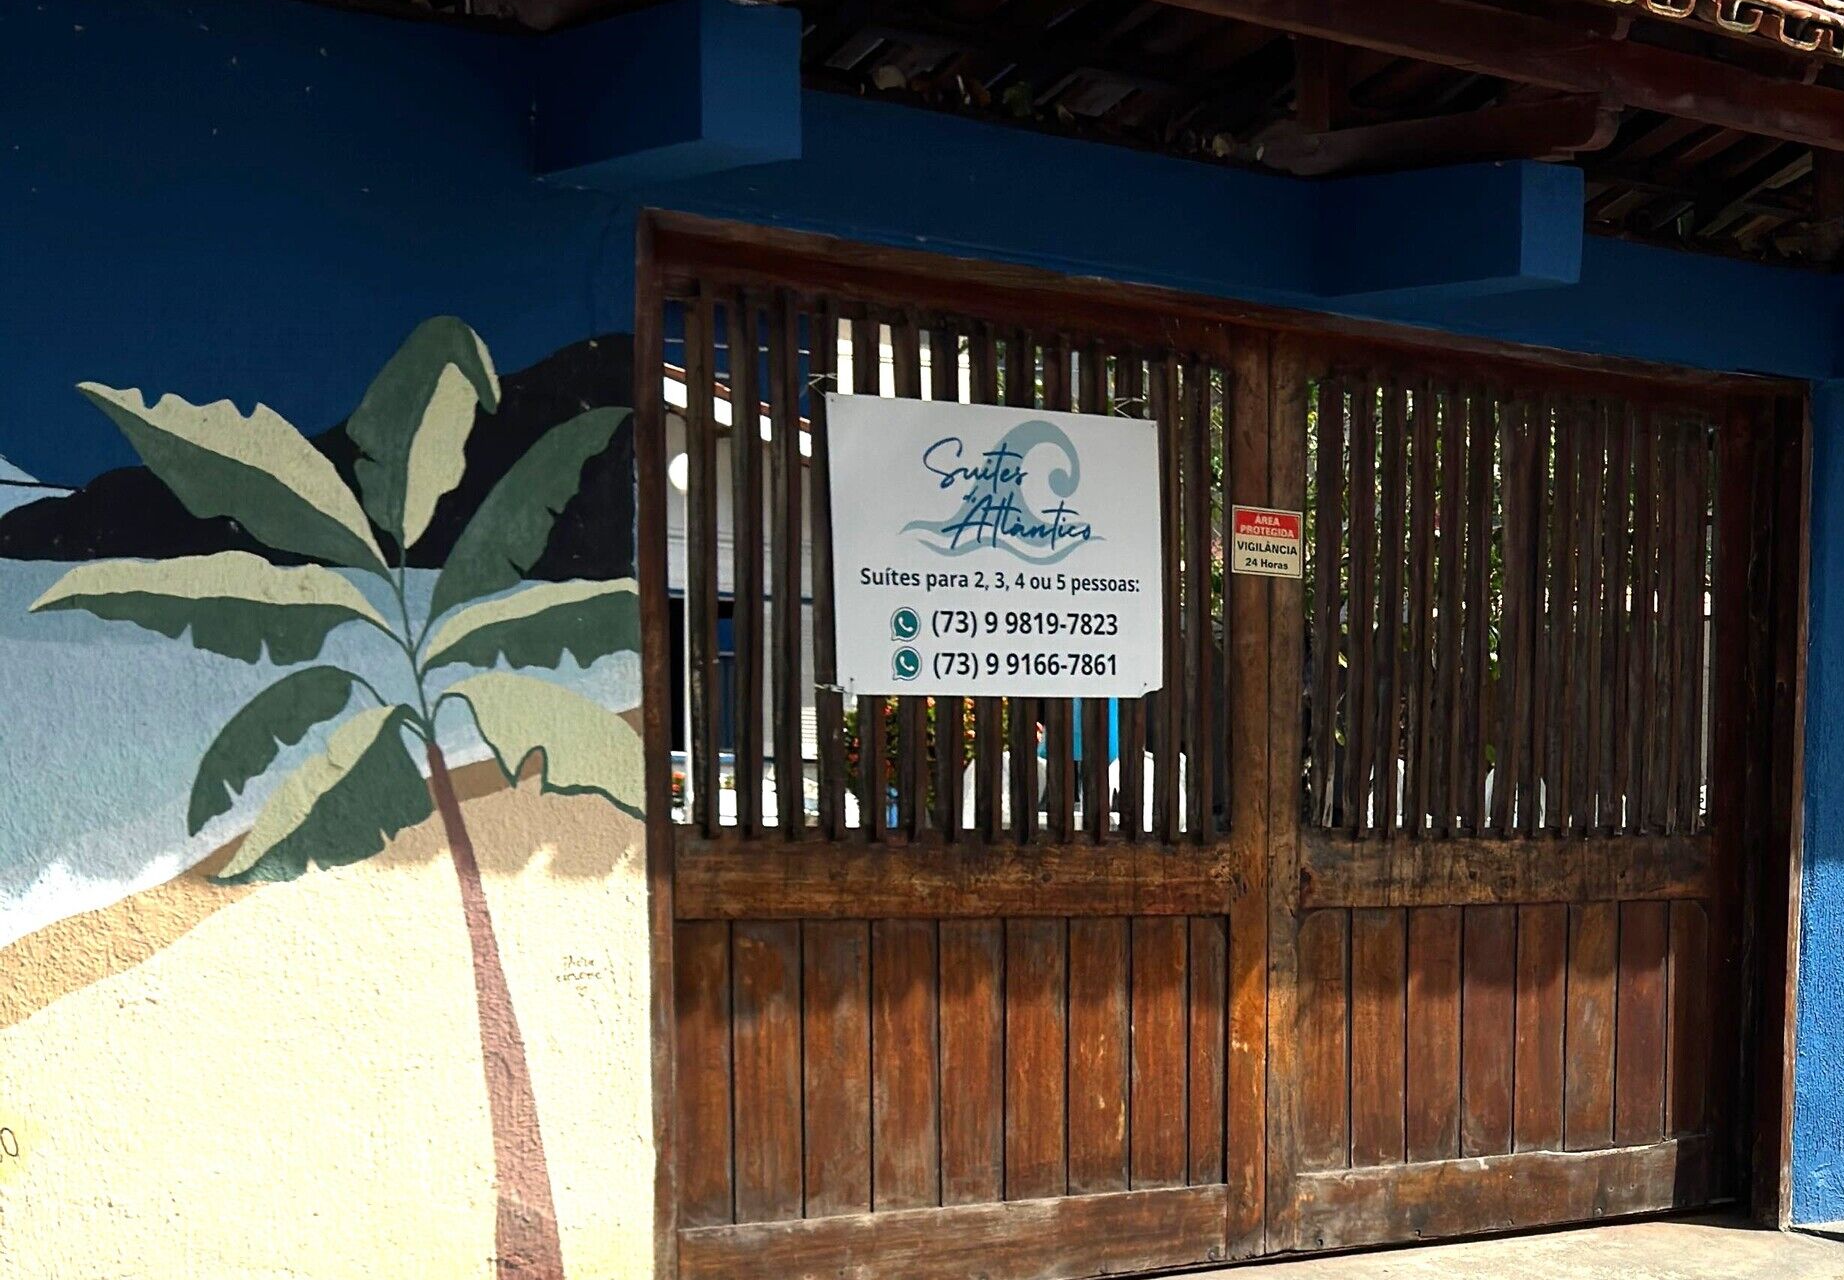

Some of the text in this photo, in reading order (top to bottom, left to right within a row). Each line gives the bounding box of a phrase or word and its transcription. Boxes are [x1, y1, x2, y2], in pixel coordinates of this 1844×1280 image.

[1254, 514, 1280, 526] ÁREA
[1240, 524, 1294, 538] PROTEGIDA
[1237, 540, 1297, 555] VIGILÂNCIA
[1245, 558, 1288, 570] 24 Horas
[860, 567, 1140, 595] Suítes para 2, 3, 4 ou 5 pessoas:
[932, 610, 1118, 637] (73) 9 9819-7823
[933, 652, 1117, 679] (73) 9 9166-7861
